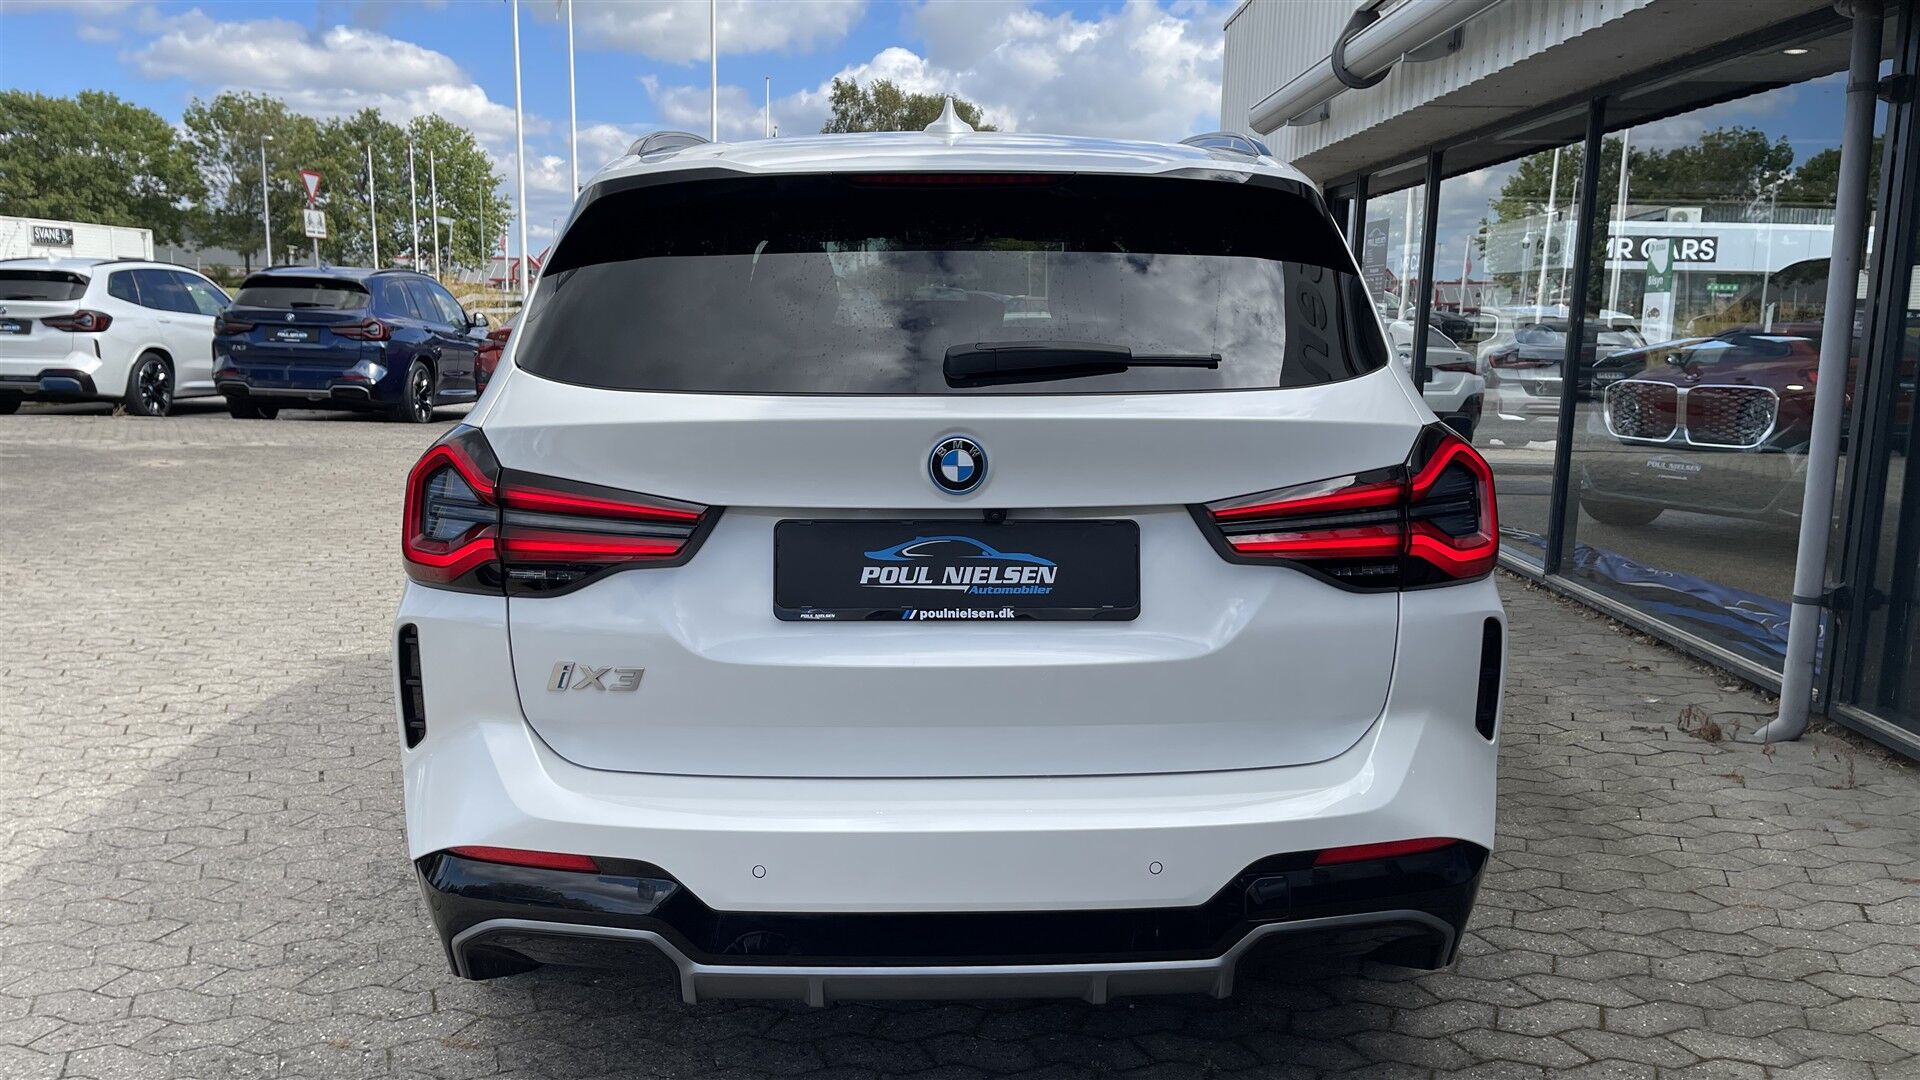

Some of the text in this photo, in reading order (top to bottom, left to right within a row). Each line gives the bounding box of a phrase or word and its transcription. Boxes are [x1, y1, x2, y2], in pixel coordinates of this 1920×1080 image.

[34, 227, 61, 240] SVANE
[860, 566, 1058, 584] POUL NIELSEN
[968, 585, 1053, 595] Automobiler
[919, 608, 1015, 620] poulnielsen.dk
[547, 660, 645, 692] iX3
